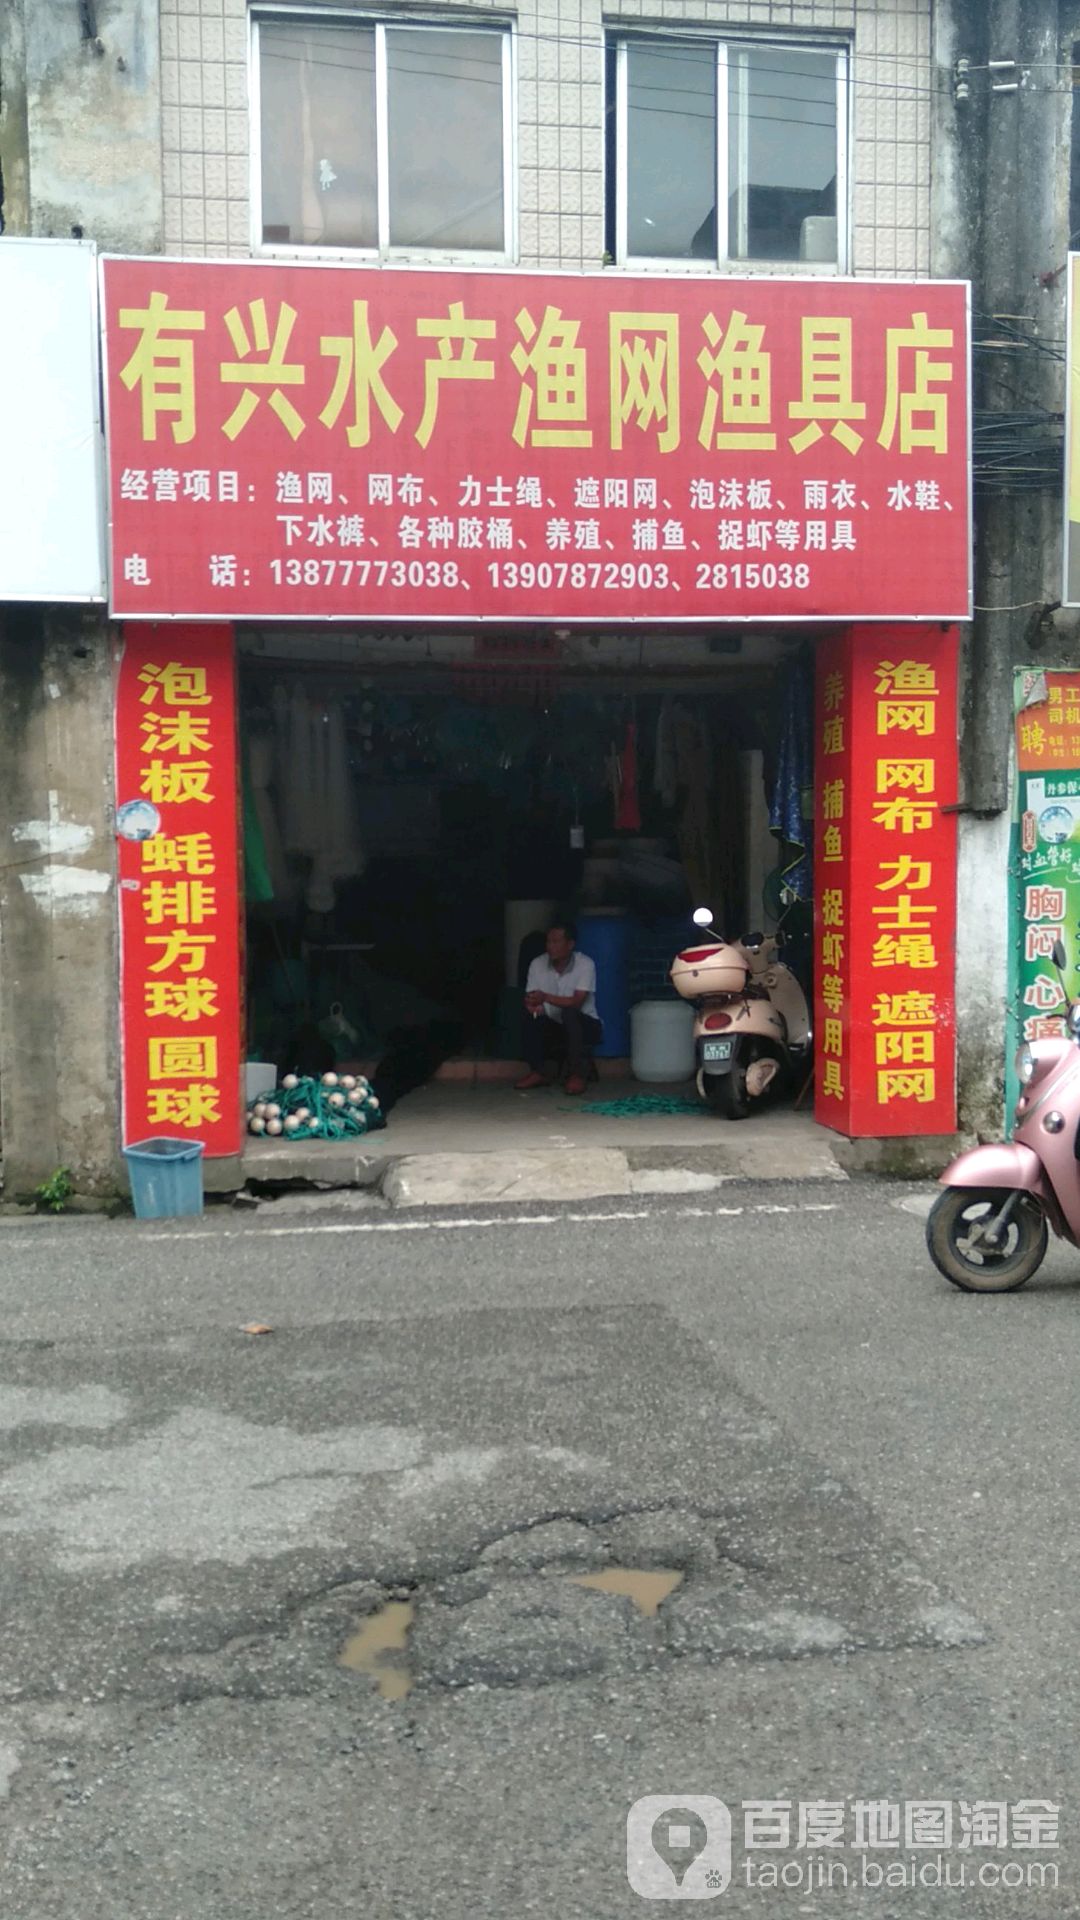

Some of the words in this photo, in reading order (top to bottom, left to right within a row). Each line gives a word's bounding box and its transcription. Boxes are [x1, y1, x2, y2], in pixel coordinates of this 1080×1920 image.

[119, 292, 953, 455] 有兴水产渔网渔具店
[138, 662, 215, 804] 泡沫板
[822, 672, 845, 755] 养殖
[872, 660, 939, 736] 渔网
[822, 778, 845, 863] 捕鱼
[872, 758, 938, 834] 网布
[140, 831, 219, 1022] 蚝排方球
[871, 855, 938, 969] 力士绳
[822, 888, 845, 1101] 捉虾等用具
[871, 990, 937, 1104] 遮阳网
[146, 1036, 222, 1128] 圆球
